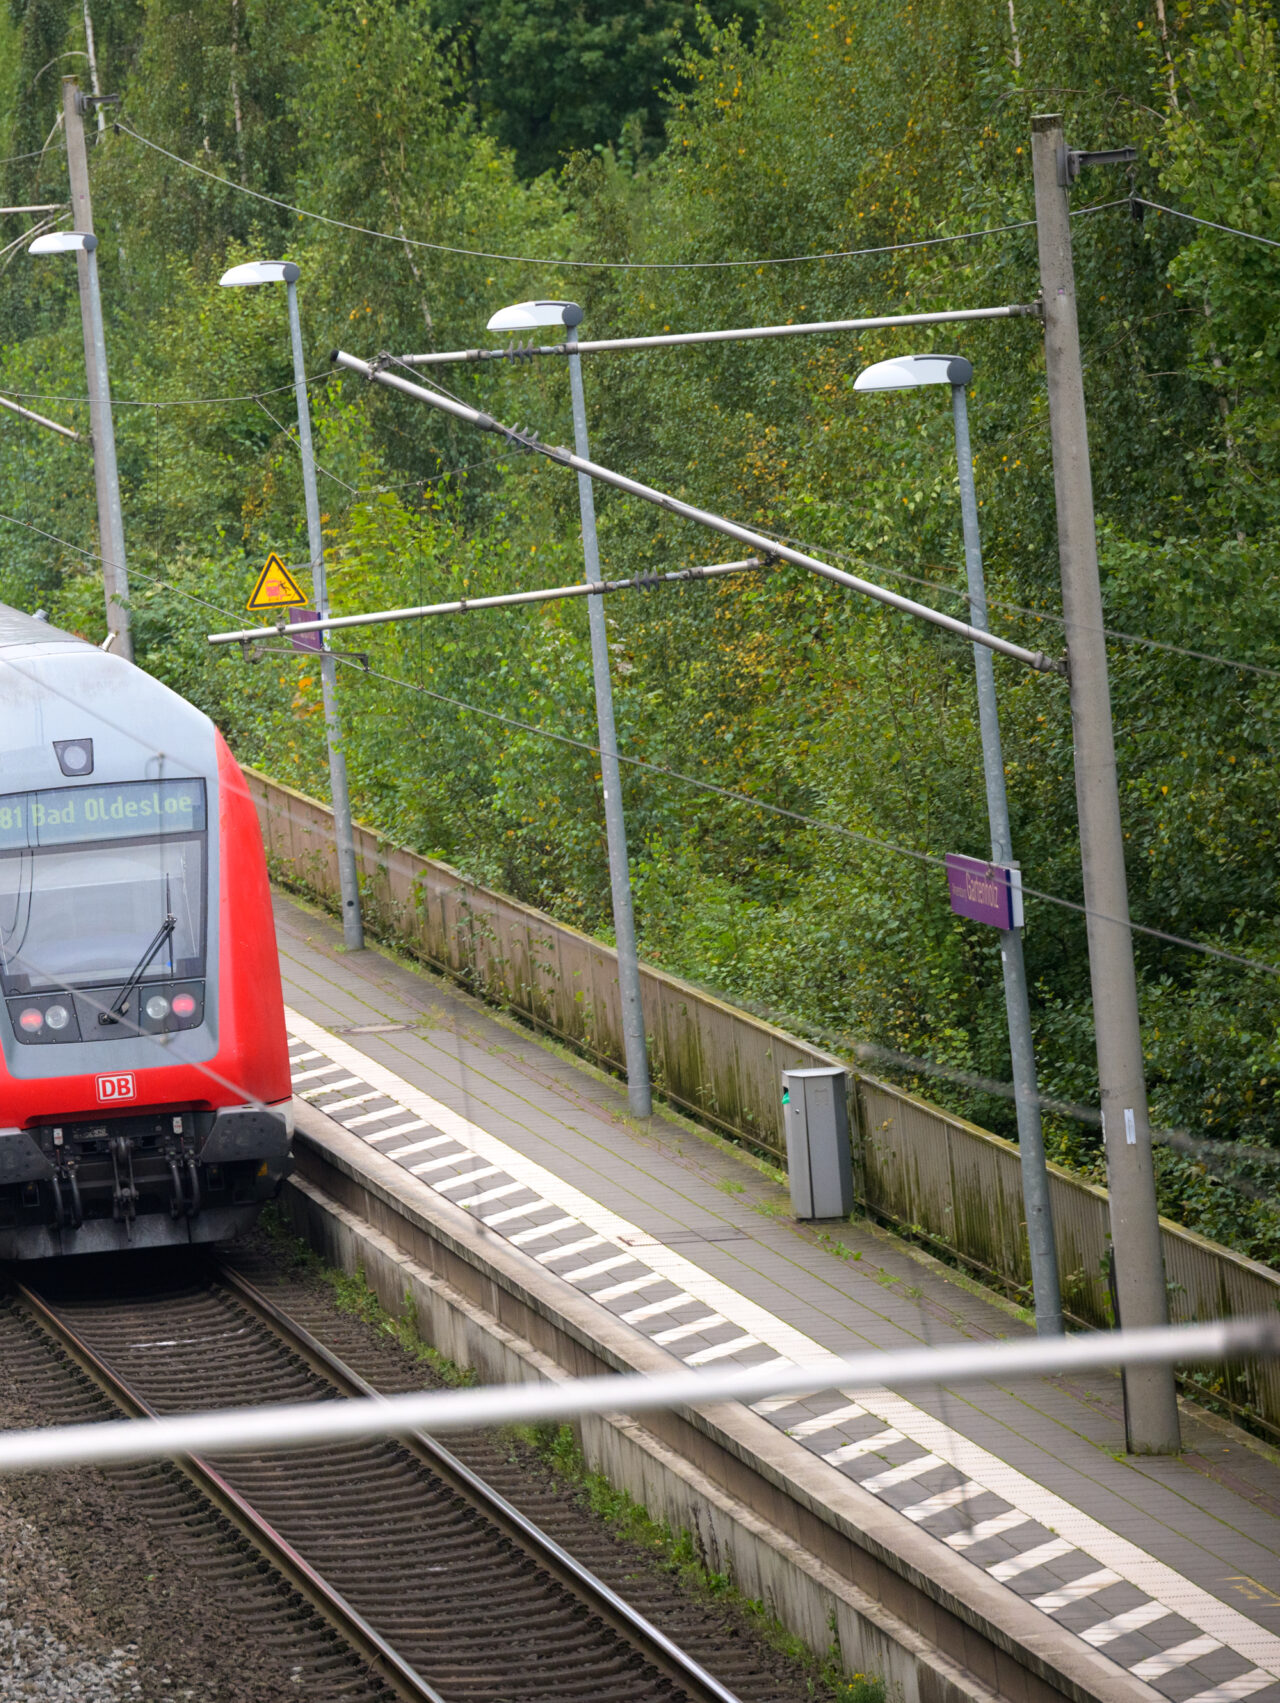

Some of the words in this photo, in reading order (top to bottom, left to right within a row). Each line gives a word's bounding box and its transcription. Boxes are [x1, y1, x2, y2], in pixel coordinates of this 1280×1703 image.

[31, 800, 75, 826] Bad
[84, 793, 192, 821] Oldesloe
[101, 1077, 131, 1098] DB
